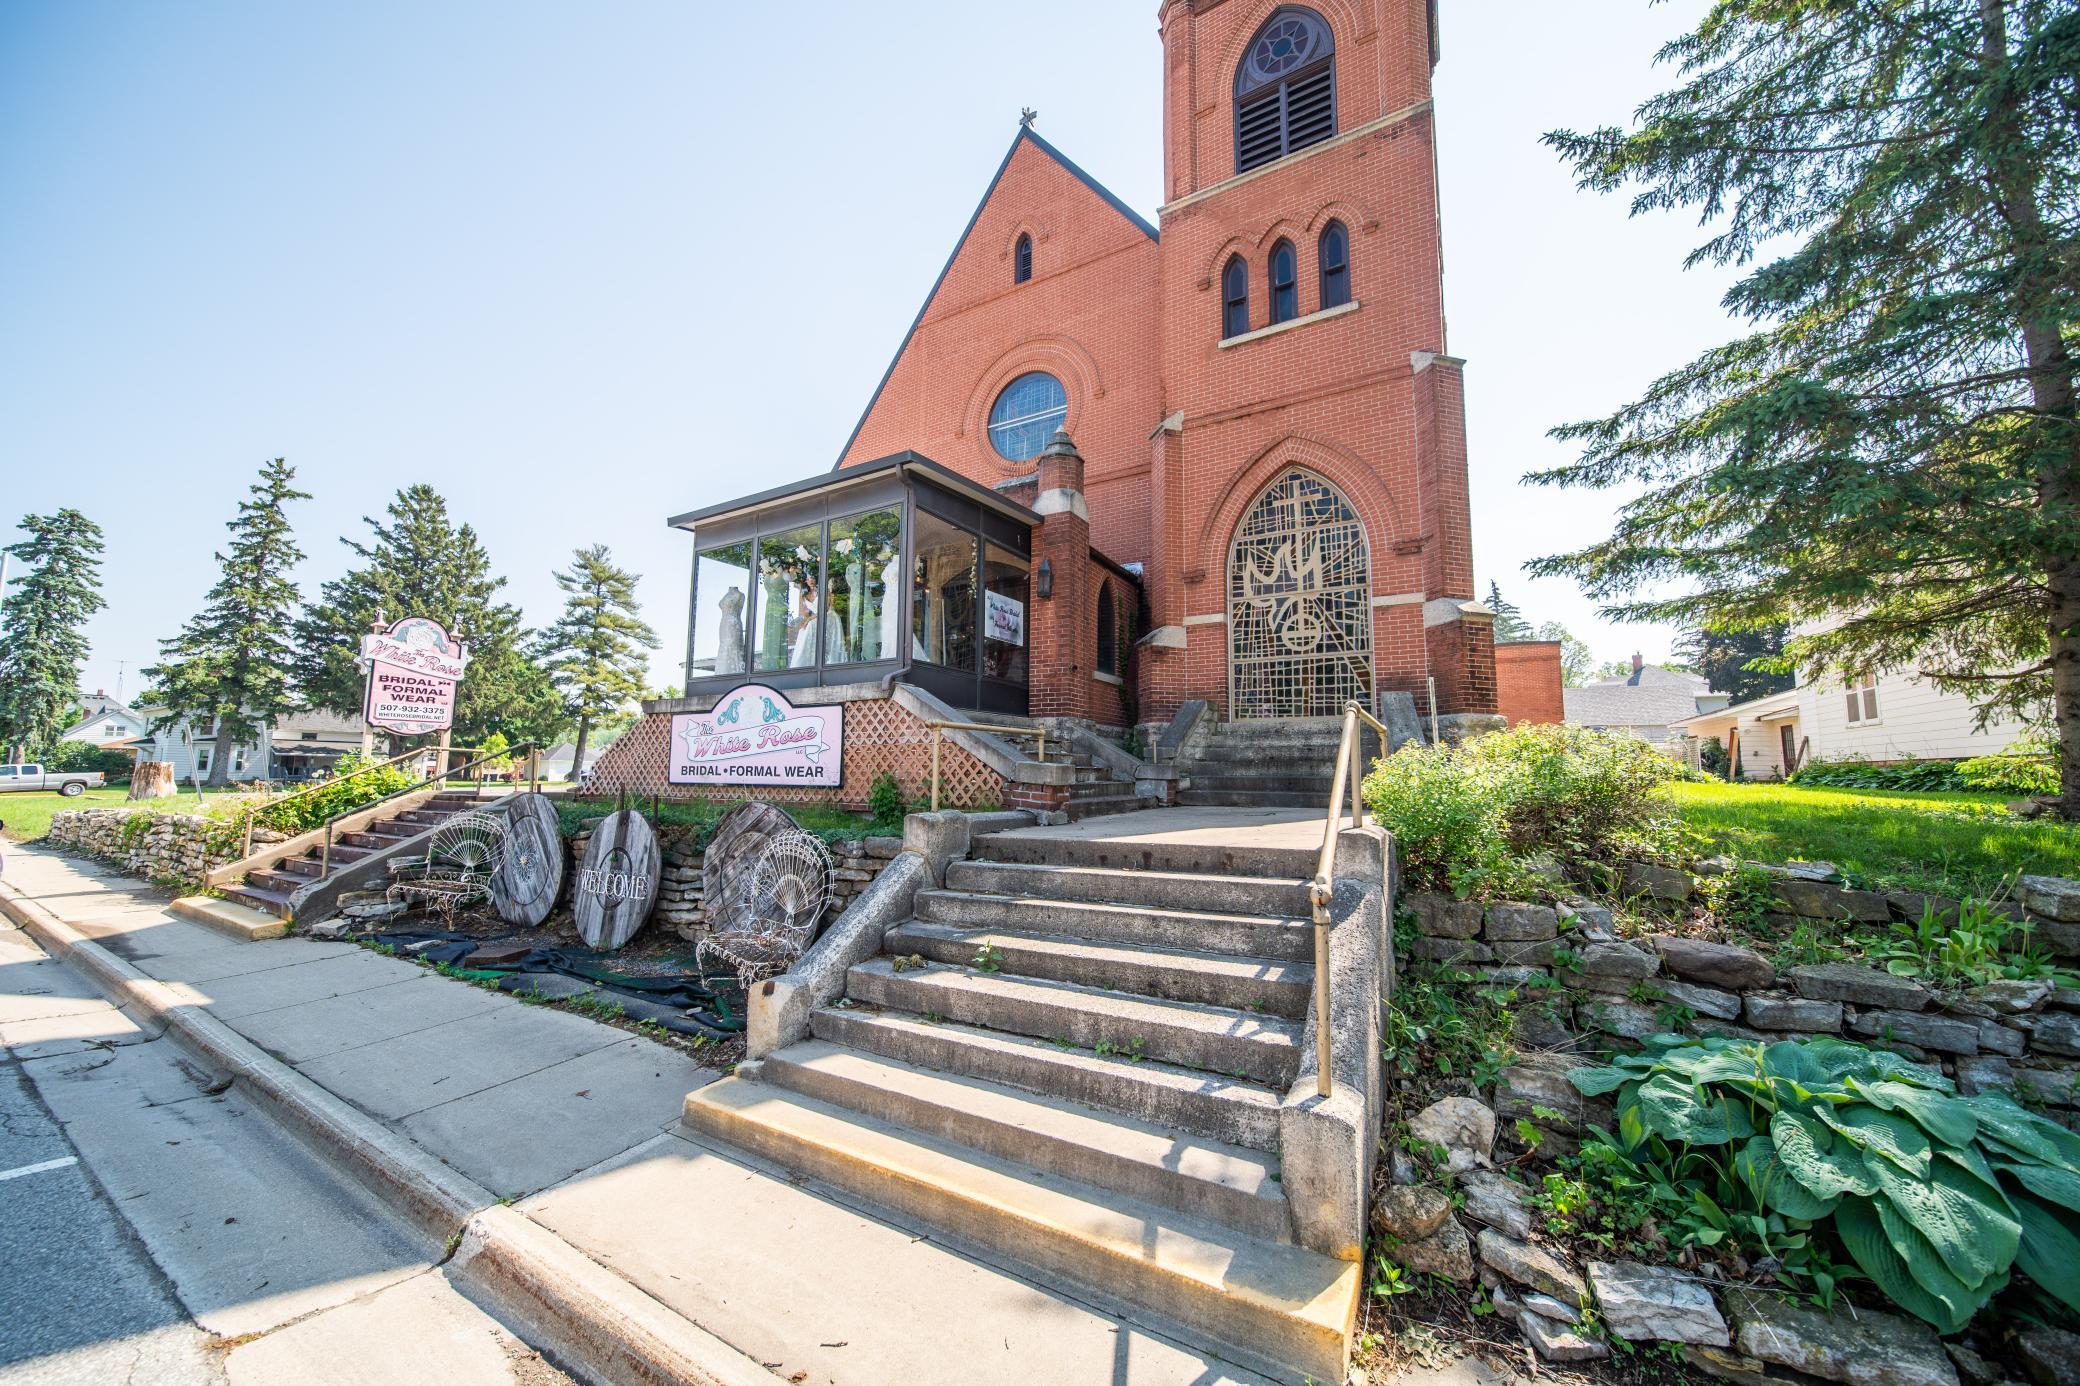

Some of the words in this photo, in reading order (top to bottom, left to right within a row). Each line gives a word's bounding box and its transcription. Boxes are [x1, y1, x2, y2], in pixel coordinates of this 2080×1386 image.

[370, 640, 417, 665] White
[419, 655, 462, 676] Rose
[379, 675, 436, 687] BRIDAL
[383, 684, 447, 696] FORMAL
[391, 694, 436, 704] WEAR
[380, 704, 445, 715] 507-932-3375
[700, 721, 714, 735] The
[694, 736, 751, 758] White
[757, 725, 818, 749] Rose
[681, 765, 721, 777] BRIDAL
[729, 765, 780, 777] FORMAL
[784, 766, 824, 778] WEAR
[581, 868, 646, 901] WELCOME
